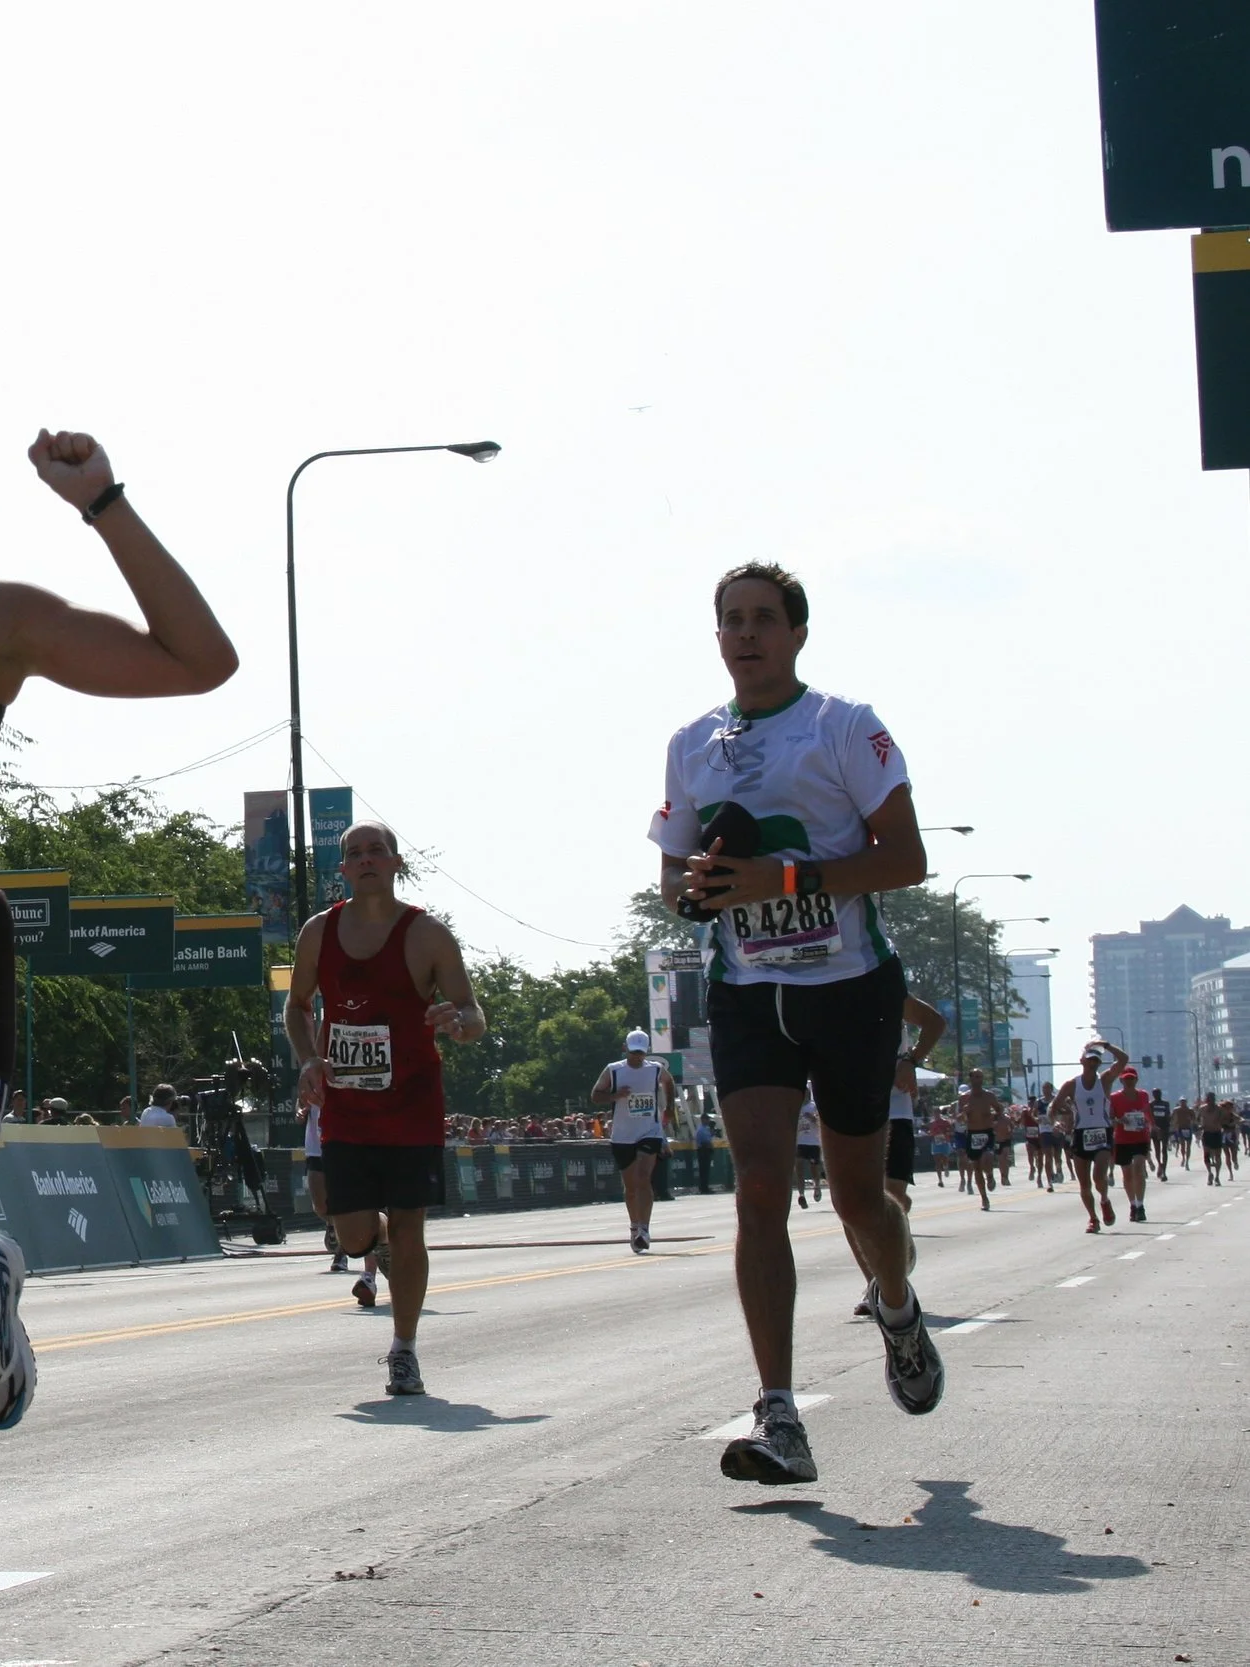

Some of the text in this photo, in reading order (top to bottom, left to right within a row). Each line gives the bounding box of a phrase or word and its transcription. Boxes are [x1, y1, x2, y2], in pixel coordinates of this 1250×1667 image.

[10, 906, 43, 920] ibune
[761, 892, 835, 938] 4288
[70, 926, 87, 937] ank
[100, 925, 146, 937] America
[19, 931, 44, 946] you?
[217, 945, 247, 958] Bank
[329, 1039, 386, 1066] 40785
